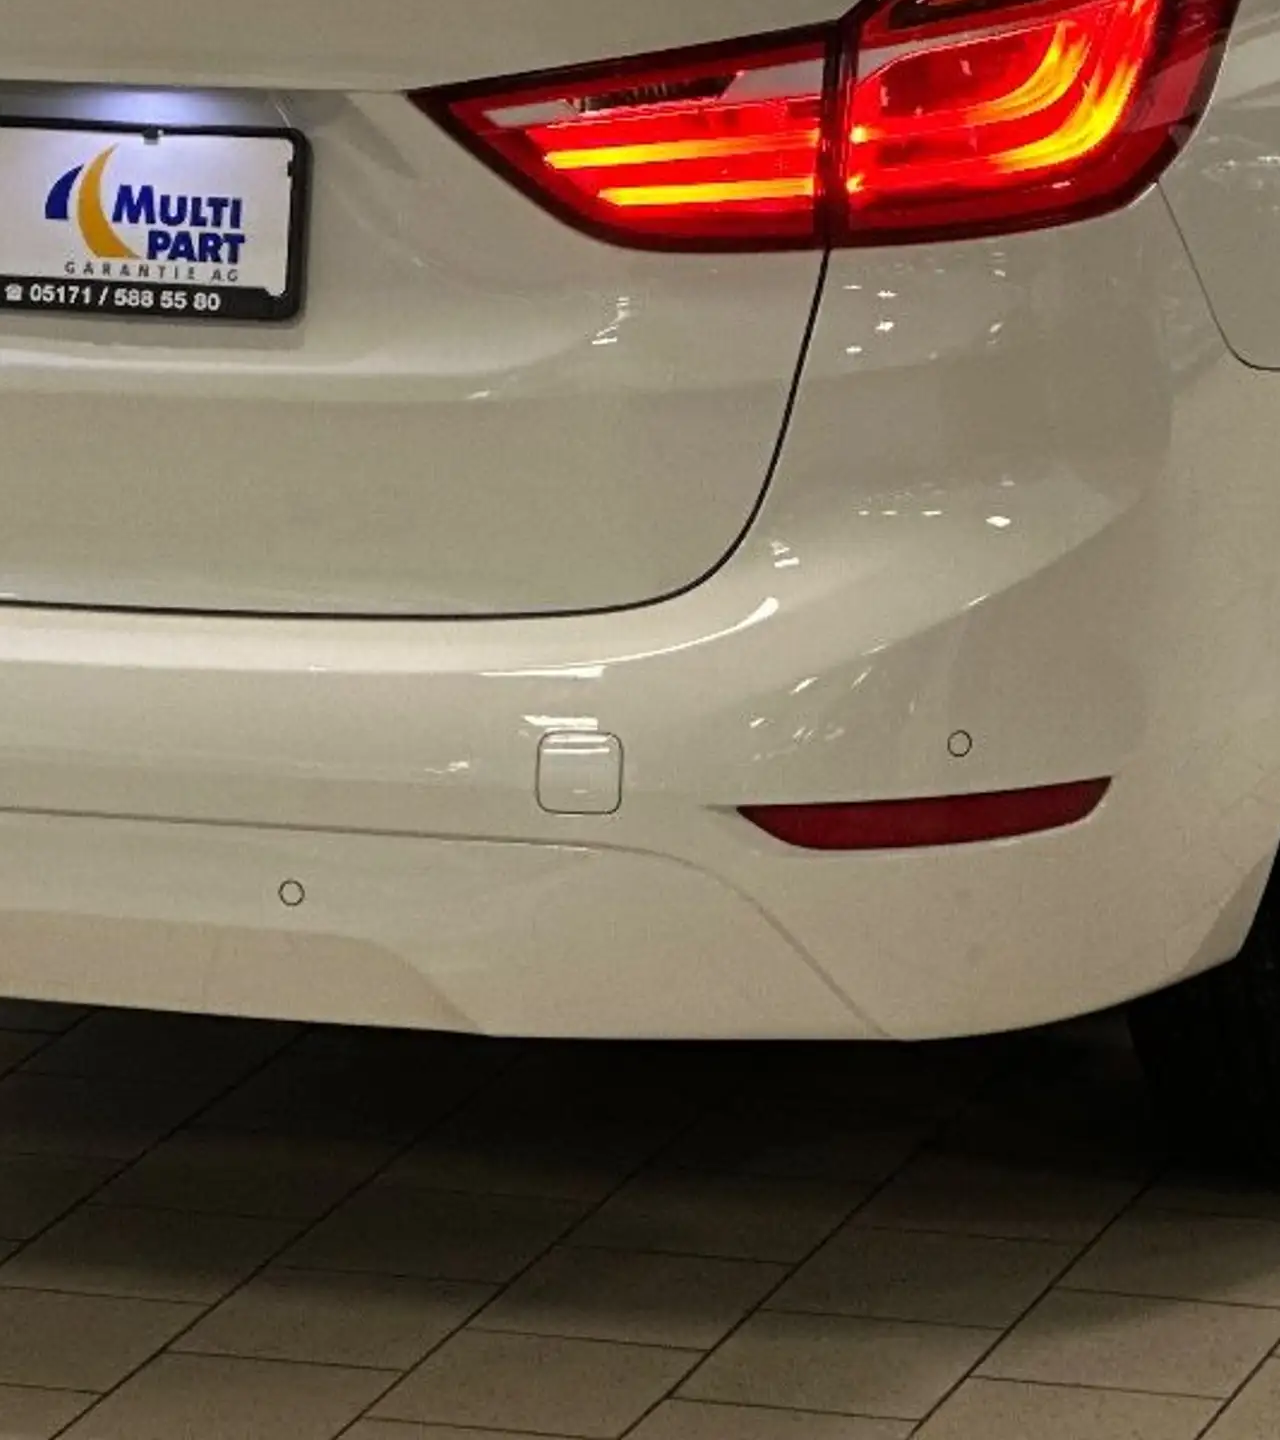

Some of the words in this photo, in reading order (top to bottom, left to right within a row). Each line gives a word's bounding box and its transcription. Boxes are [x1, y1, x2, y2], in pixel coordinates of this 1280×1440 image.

[111, 184, 243, 229] MULTI
[146, 230, 246, 264] PART
[64, 261, 196, 280] GARANTIE
[211, 271, 239, 282] AG
[30, 284, 92, 304] 05171
[98, 286, 111, 305] /
[114, 289, 154, 308] 588
[160, 291, 187, 310] 55
[193, 292, 221, 311] 80
